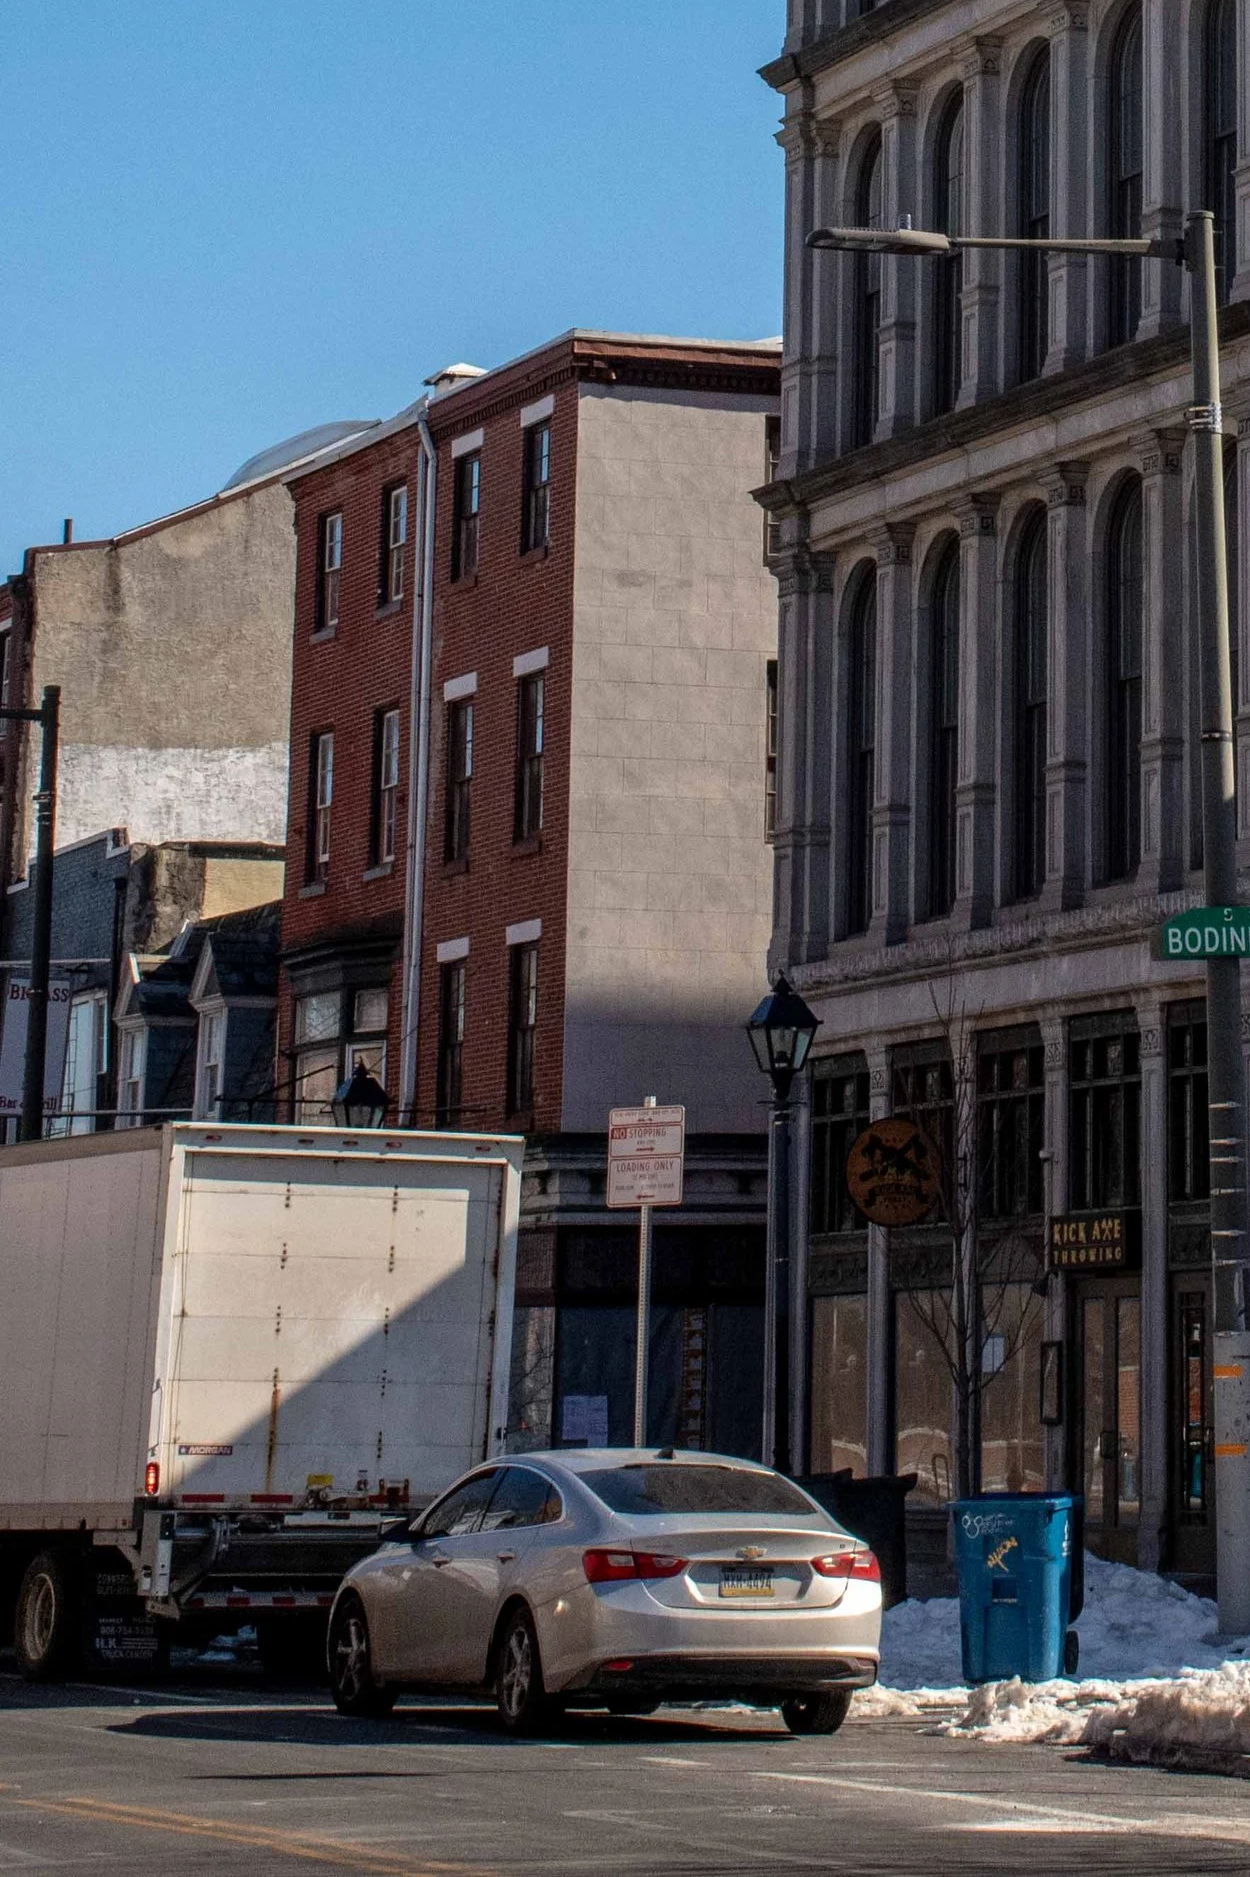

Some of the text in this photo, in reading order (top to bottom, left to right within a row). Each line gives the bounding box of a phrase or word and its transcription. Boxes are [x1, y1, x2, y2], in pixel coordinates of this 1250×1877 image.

[612, 1127, 666, 1139] NO STOPPING
[616, 1160, 674, 1173] LOADING ONLY
[1053, 1217, 1121, 1245] KICK AXE
[1053, 1246, 1122, 1265] THROWING
[188, 1446, 232, 1455] MORGAN
